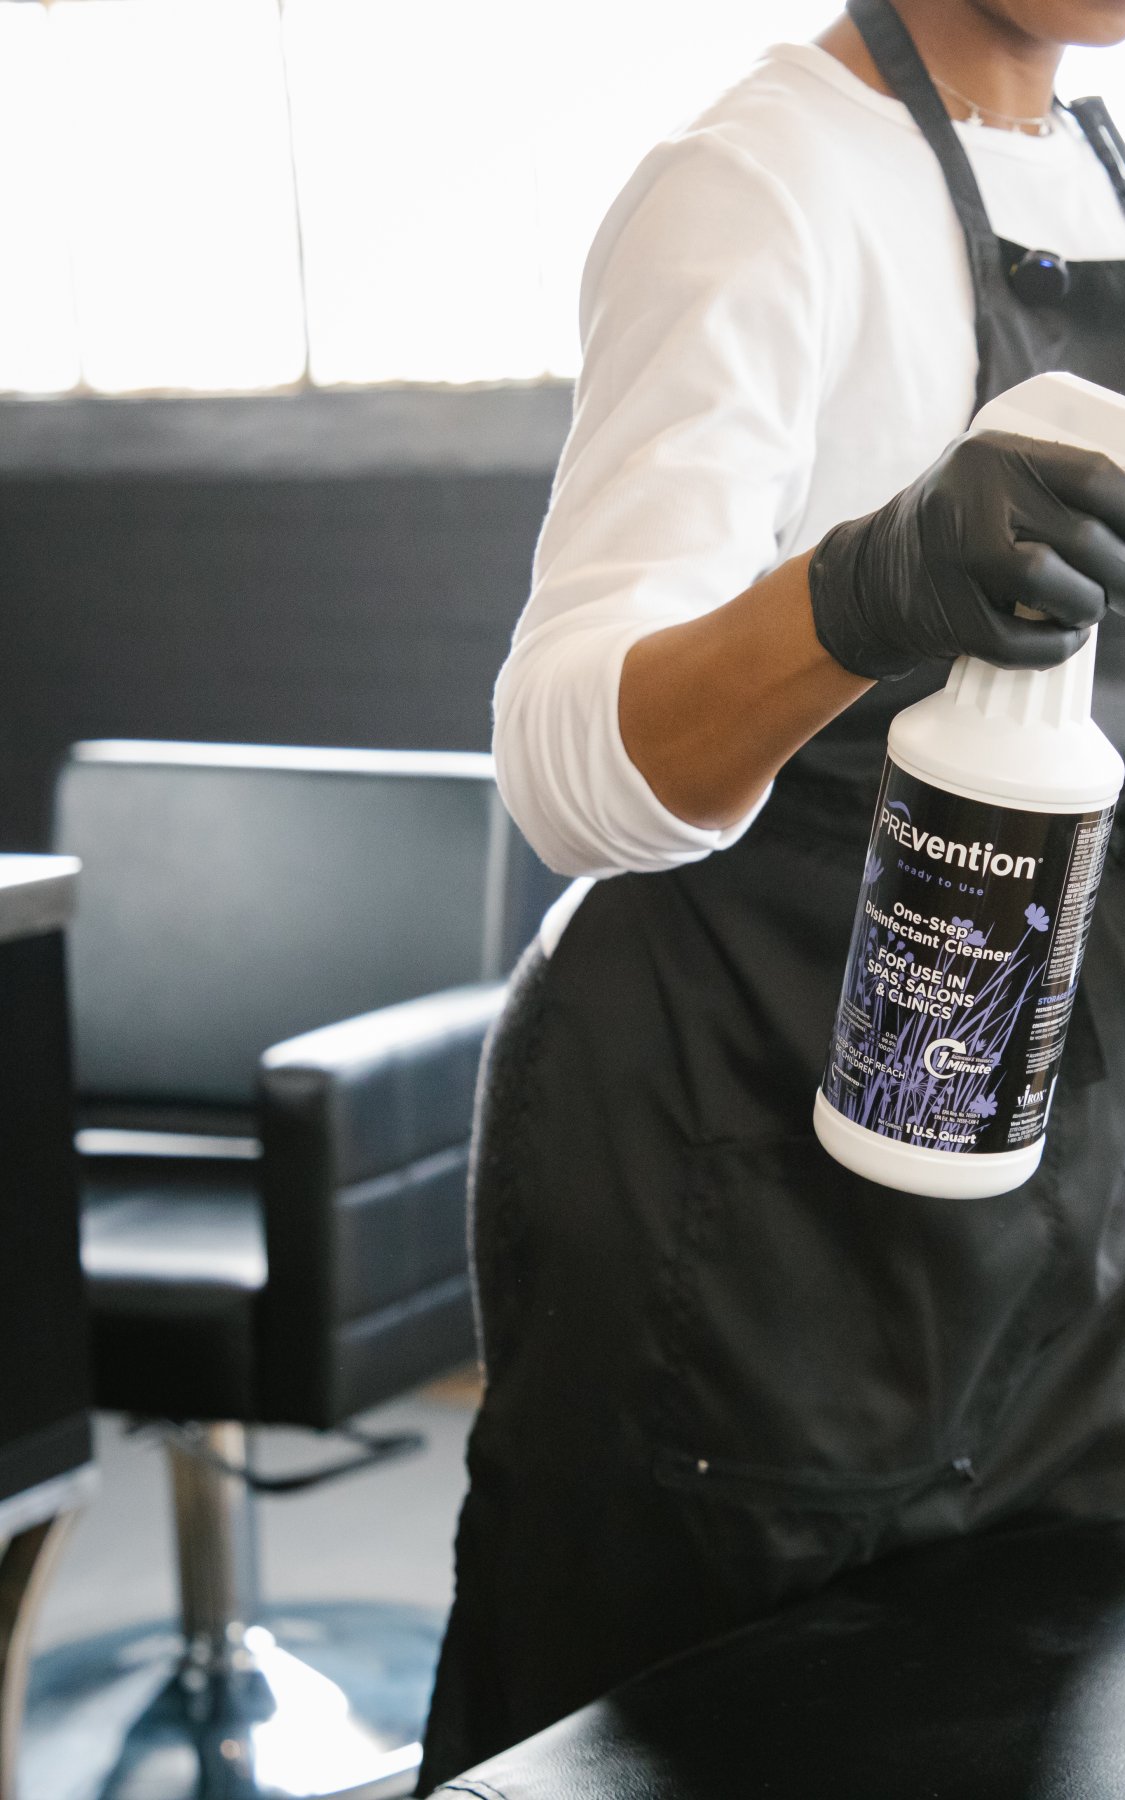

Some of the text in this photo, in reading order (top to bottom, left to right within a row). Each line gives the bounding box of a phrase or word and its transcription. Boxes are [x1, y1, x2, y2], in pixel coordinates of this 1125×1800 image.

[898, 859, 984, 896] Ready to Use
[865, 900, 940, 949] Disinfectant
[944, 939, 1012, 962] Cleaner
[867, 959, 975, 1008] SPAS, SALONS
[878, 947, 966, 990] FOR USE IN
[876, 982, 885, 997] &
[888, 988, 952, 1020] CLINICS
[842, 1049, 874, 1076] CHILDREN
[848, 1045, 863, 1059] OUT
[863, 1055, 875, 1065] OF
[875, 1062, 906, 1080] REACH
[936, 1051, 950, 1068] 1
[945, 1059, 992, 1075] Minute
[905, 1123, 977, 1145] 1 U.S. Quart
